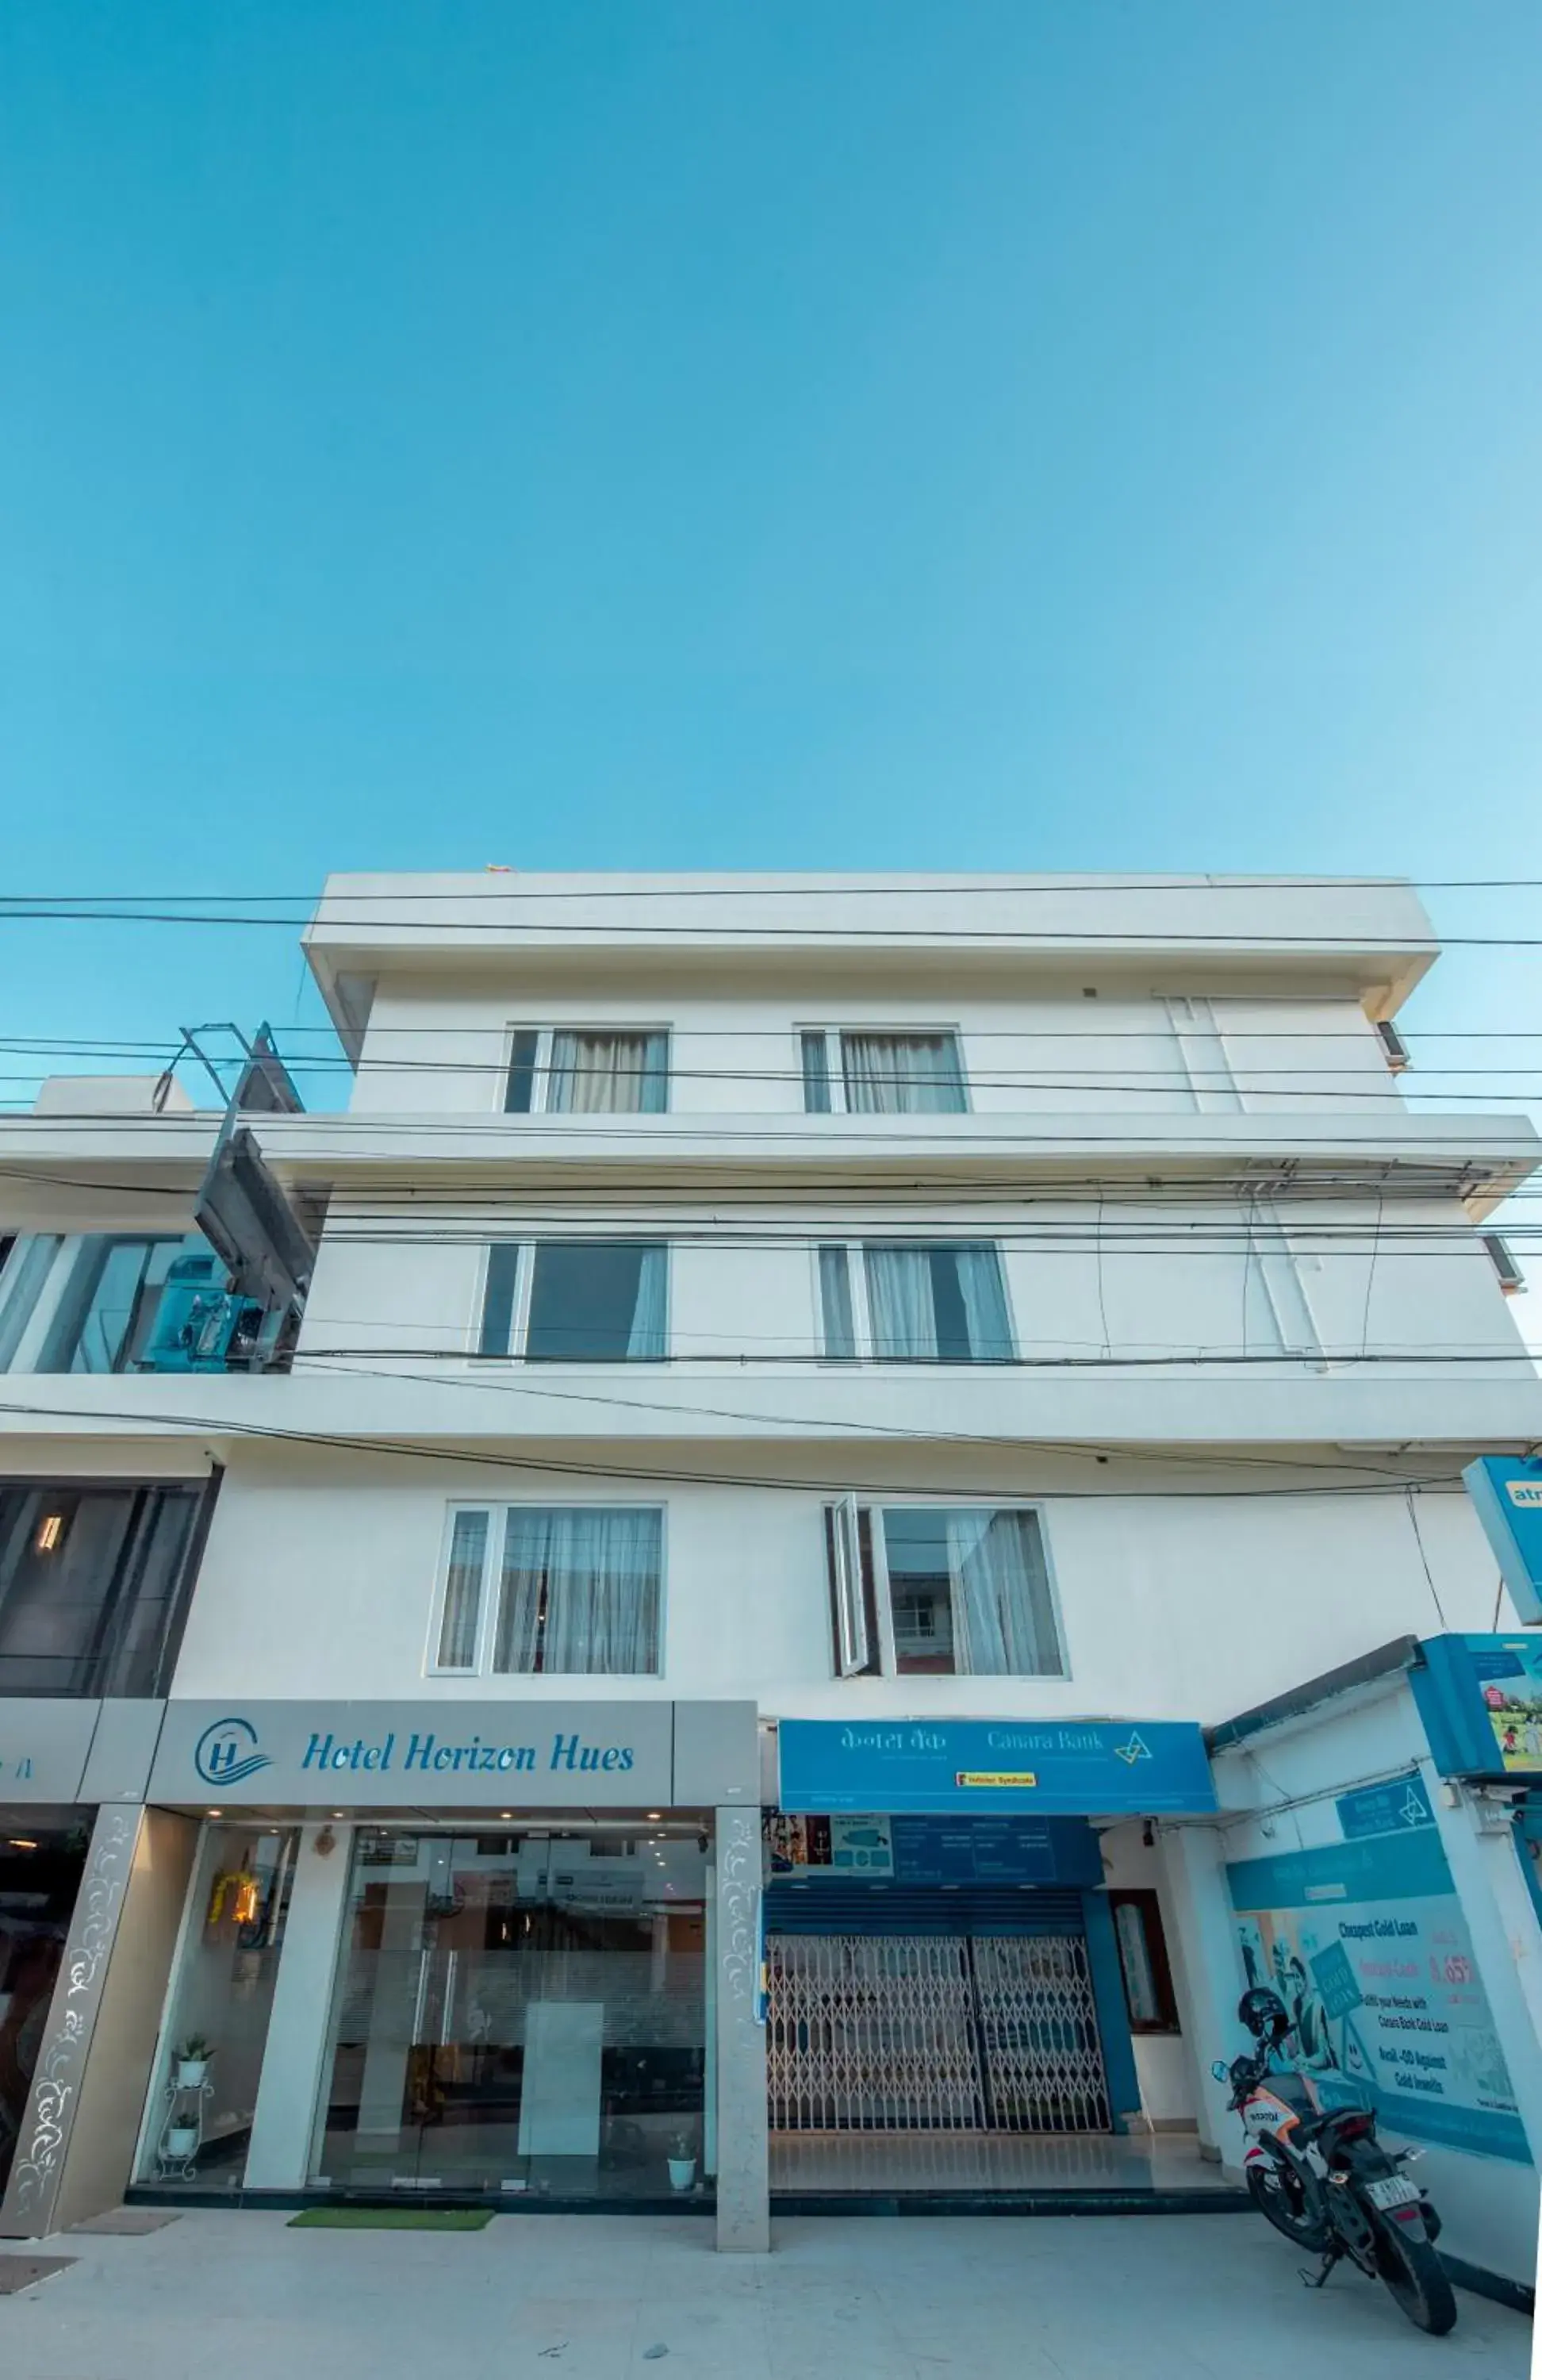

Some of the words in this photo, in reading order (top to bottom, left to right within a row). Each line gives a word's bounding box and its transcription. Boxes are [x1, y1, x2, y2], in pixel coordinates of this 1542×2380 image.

[301, 1733, 394, 1771] Hotel
[404, 1733, 536, 1771] Horizon
[550, 1733, 634, 1771] Hues
[988, 1730, 1053, 1750] Canara
[1057, 1729, 1103, 1750] Bank
